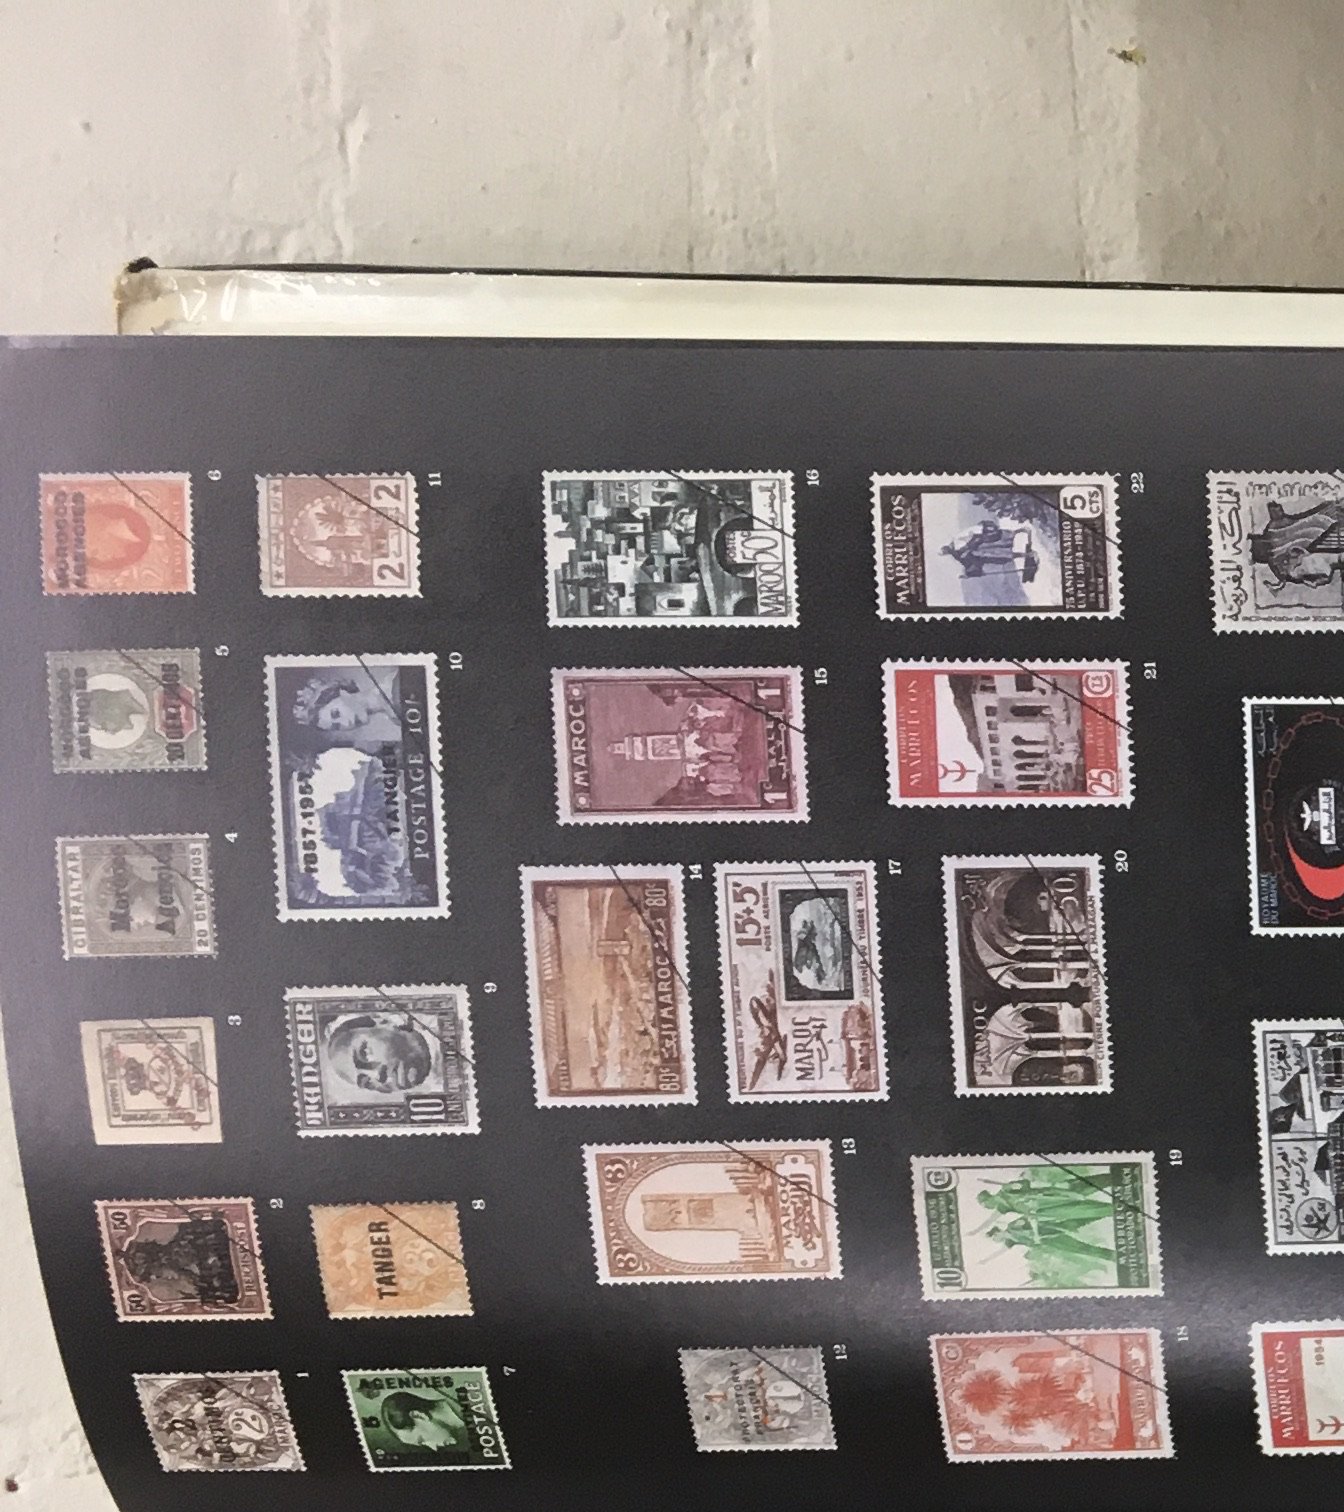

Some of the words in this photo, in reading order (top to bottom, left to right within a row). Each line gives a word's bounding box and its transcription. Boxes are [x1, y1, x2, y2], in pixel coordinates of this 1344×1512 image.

[374, 484, 402, 502] 2
[428, 471, 442, 487] 11
[1063, 493, 1087, 513] 5
[1088, 489, 1099, 515] CTS
[53, 490, 71, 590] MOROCCO
[71, 491, 89, 589] AGENCIES
[890, 494, 911, 605] MARRUECOS
[1062, 520, 1075, 595] ANIVERSARIO
[377, 561, 406, 581] 2
[757, 562, 786, 616] MAROC
[814, 667, 829, 686] 15
[1143, 661, 1158, 680] 21
[569, 703, 588, 788] MAROC
[906, 678, 923, 787] MARRUECOS
[407, 752, 429, 860] POSTAGE
[1088, 769, 1114, 794] 25
[192, 846, 209, 922] CENTIMOS
[888, 858, 902, 876] 17
[67, 851, 86, 948] GIBRALTAR
[196, 928, 209, 949] 20
[656, 954, 674, 1023] MAROC
[793, 1014, 815, 1081] MAROC
[971, 1000, 993, 1077] MAROC
[410, 1097, 446, 1121] 10
[842, 1137, 857, 1156] 13
[1169, 1149, 1184, 1167] 19
[111, 1211, 130, 1231] 50
[778, 1176, 793, 1249] MAROC
[234, 1224, 255, 1295] REICHSPOST
[368, 1220, 399, 1300] TANGER
[937, 1268, 963, 1289] 10
[127, 1293, 147, 1313] 50
[1314, 1338, 1326, 1367] 1954
[1272, 1340, 1295, 1440] MARRUECOS
[465, 1381, 499, 1458] POSTAGE
